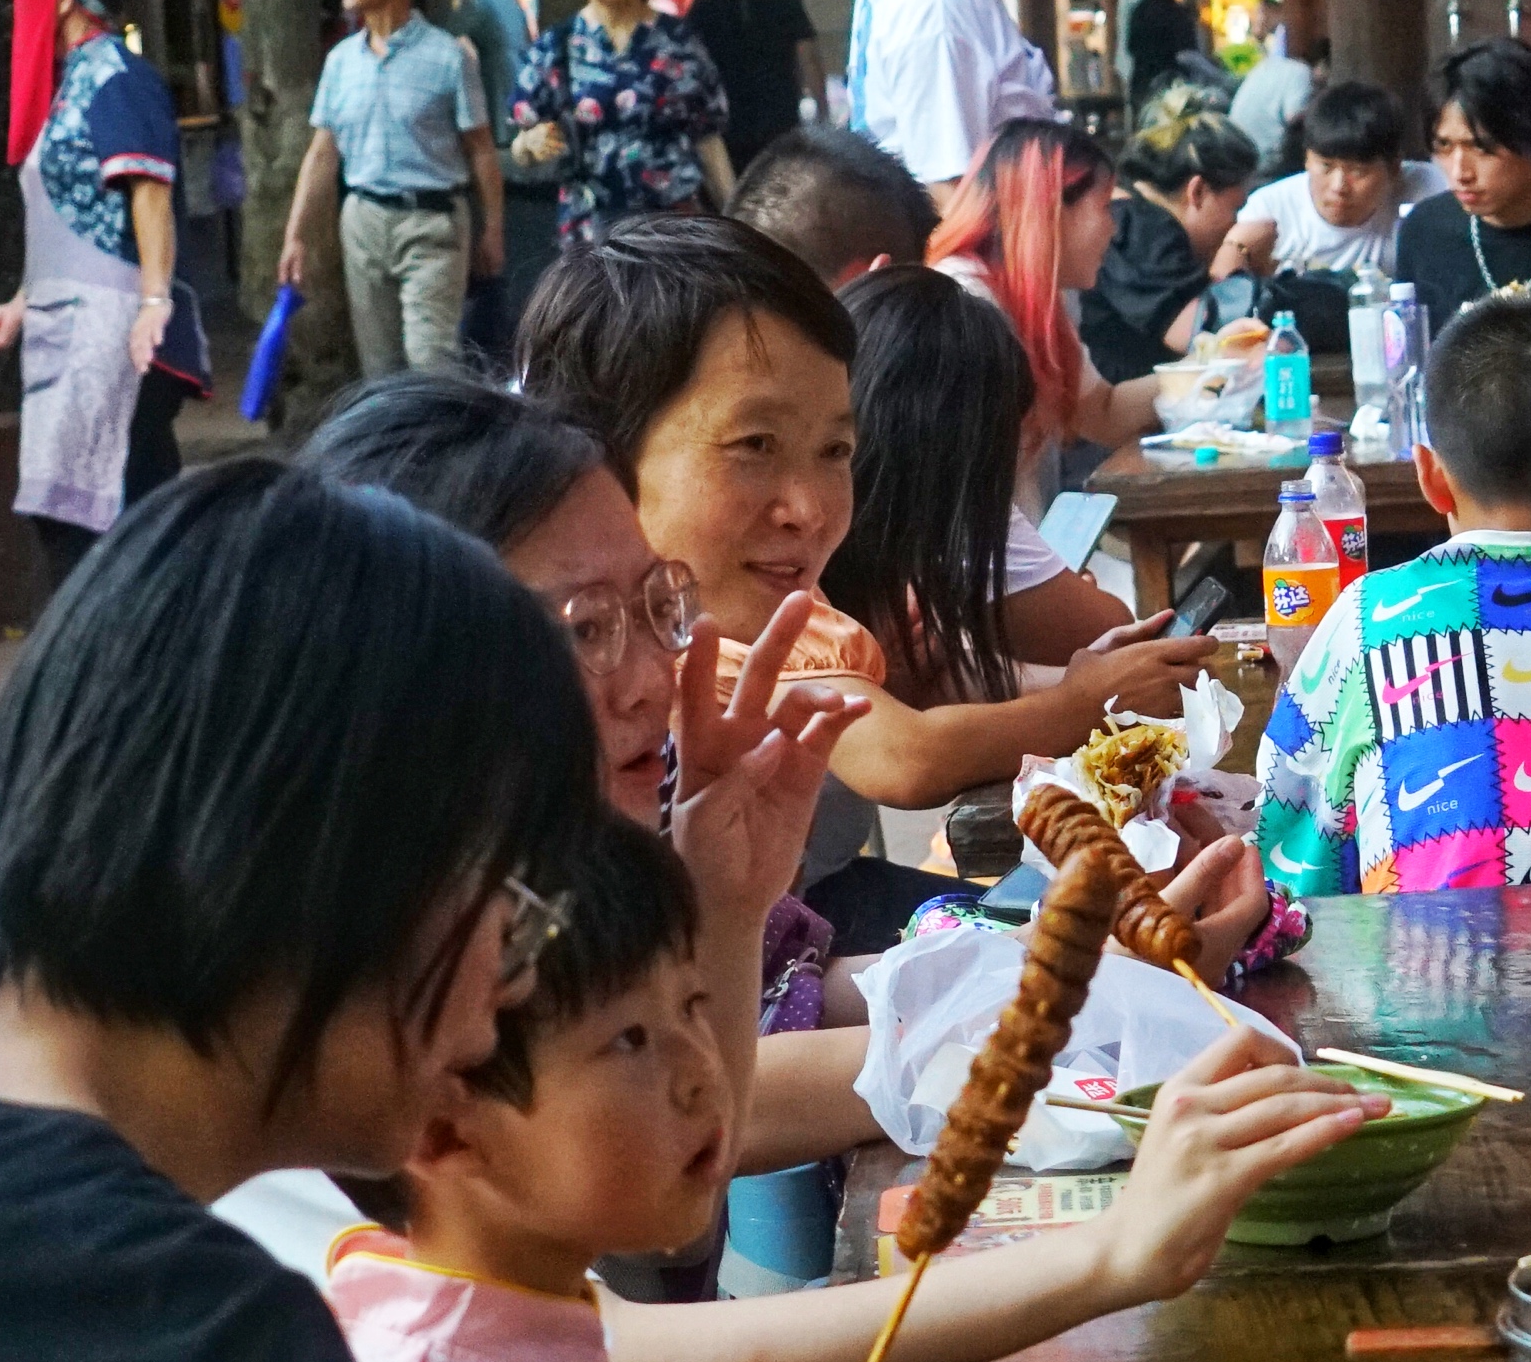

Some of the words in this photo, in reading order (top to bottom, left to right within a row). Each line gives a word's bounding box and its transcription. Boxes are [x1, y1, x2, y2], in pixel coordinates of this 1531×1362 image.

[1273, 583, 1311, 616] 芬达
[1401, 609, 1437, 623] nice
[1327, 657, 1342, 685] nice
[1426, 797, 1460, 817] nice
